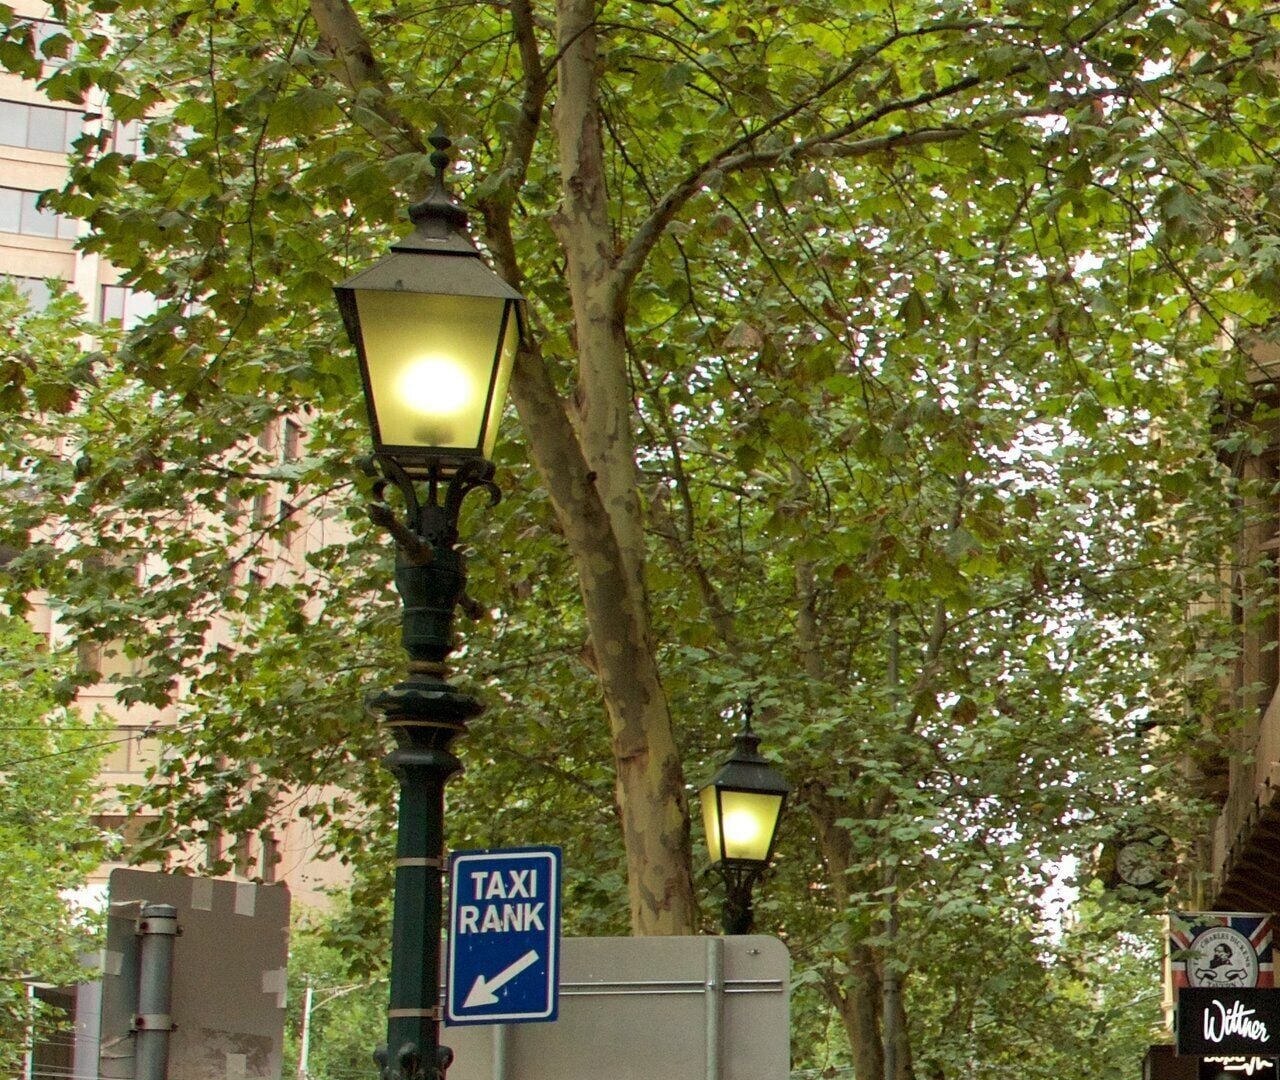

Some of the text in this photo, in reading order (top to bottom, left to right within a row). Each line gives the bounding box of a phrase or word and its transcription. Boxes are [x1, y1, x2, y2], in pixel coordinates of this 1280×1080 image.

[471, 869, 537, 900] TAXI
[460, 902, 545, 934] RANK
[1204, 999, 1270, 1042] Wittner
